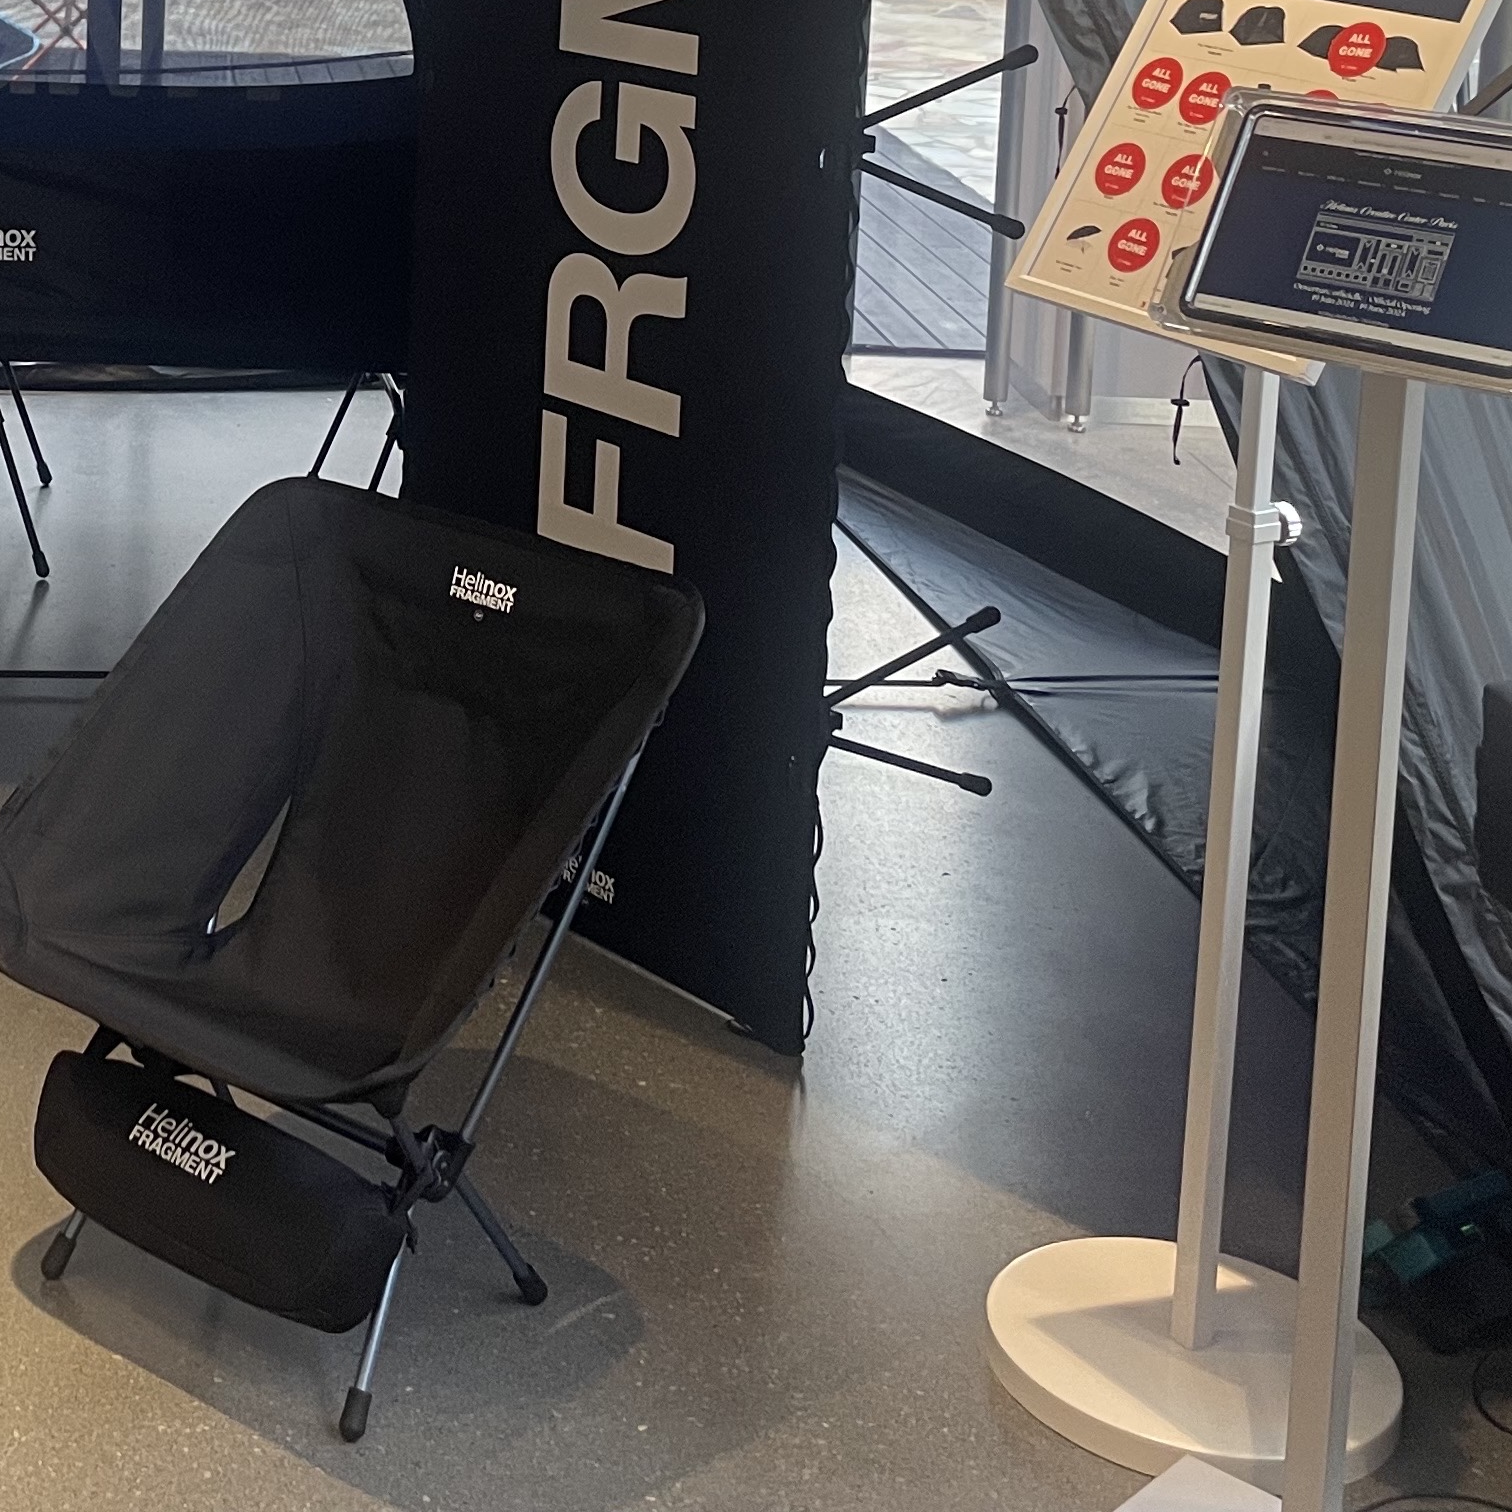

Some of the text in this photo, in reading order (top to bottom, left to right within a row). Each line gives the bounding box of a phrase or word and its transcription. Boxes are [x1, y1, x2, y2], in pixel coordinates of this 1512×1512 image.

[1349, 33, 1370, 45] ALL
[1339, 46, 1373, 58] GONE
[1152, 68, 1171, 80] ALL
[1141, 78, 1171, 93] GONE
[1199, 82, 1218, 94] ALL
[1188, 93, 1219, 107] GONE
[1114, 153, 1133, 165] ALL
[1104, 164, 1134, 179] GONE
[1181, 165, 1200, 177] ALL
[1171, 176, 1201, 191] GONE
[1128, 229, 1147, 242] ALL
[1117, 239, 1148, 257] GONE
[452, 566, 517, 602] Helinox
[449, 585, 514, 614] FRAGMENT
[138, 1102, 236, 1170] Helinox
[128, 1124, 223, 1185] FRAGMENT
